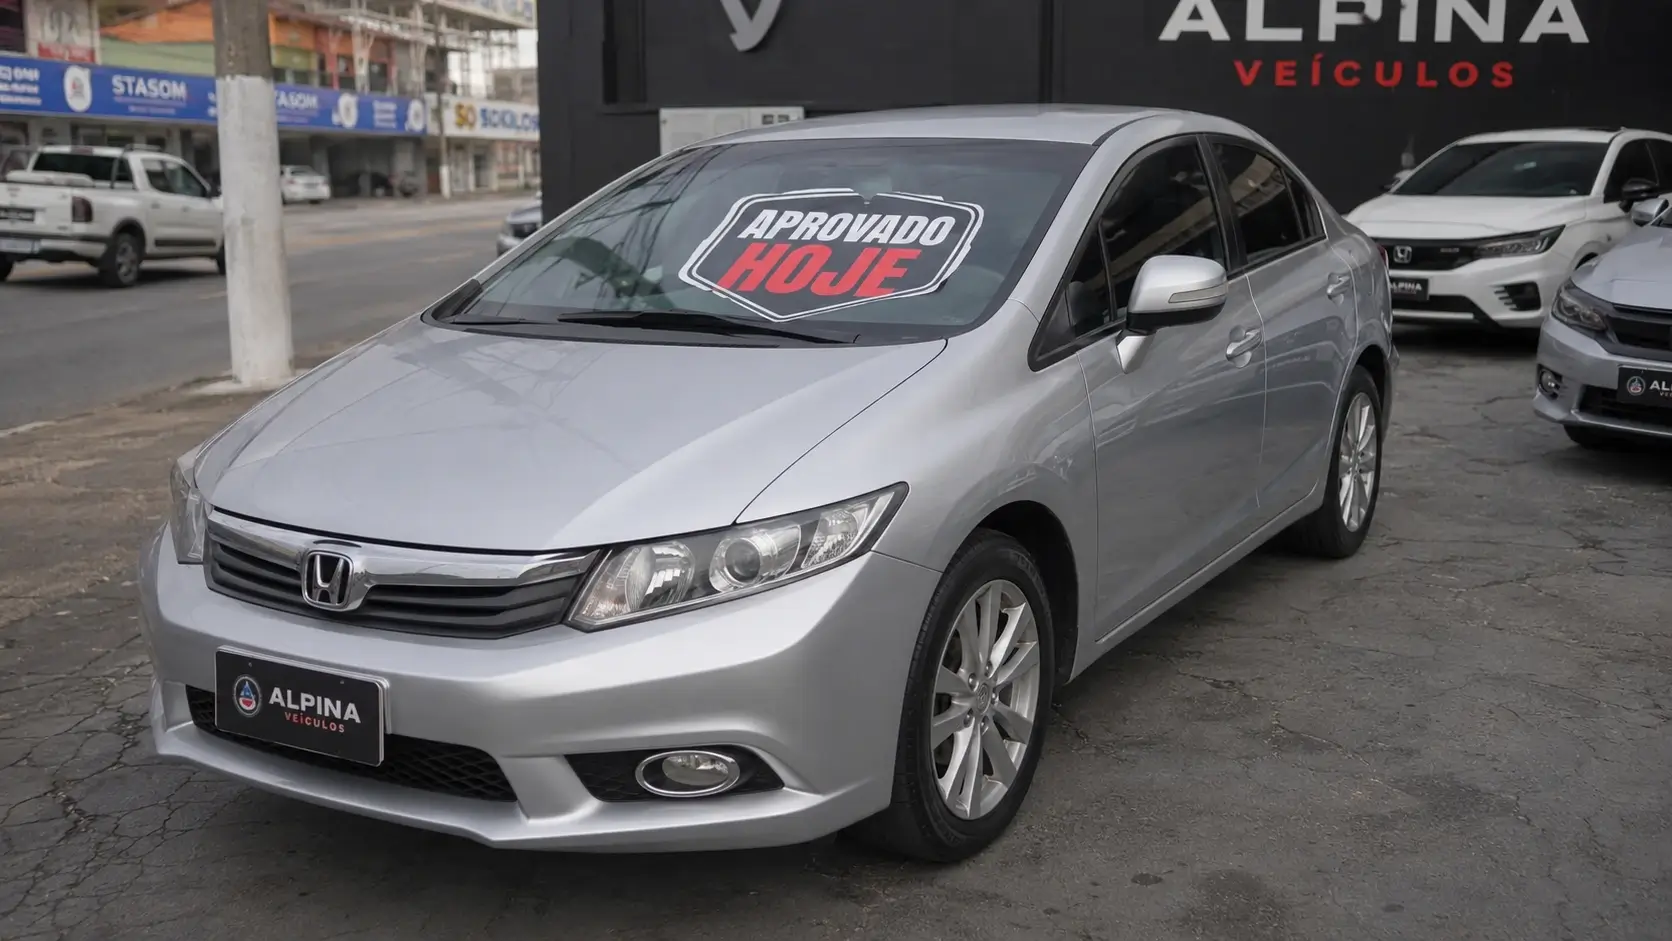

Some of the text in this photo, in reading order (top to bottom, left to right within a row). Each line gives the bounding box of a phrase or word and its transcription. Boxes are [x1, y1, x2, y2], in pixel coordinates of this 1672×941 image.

[1158, 0, 1590, 43] ALPINA
[1233, 53, 1514, 88] VEÍCULOS
[737, 209, 956, 246] APROVADO
[714, 242, 922, 298] HOJE
[1649, 380, 1672, 391] AL
[268, 686, 361, 723] ALPINA
[284, 712, 345, 733] VEÍCULOS
